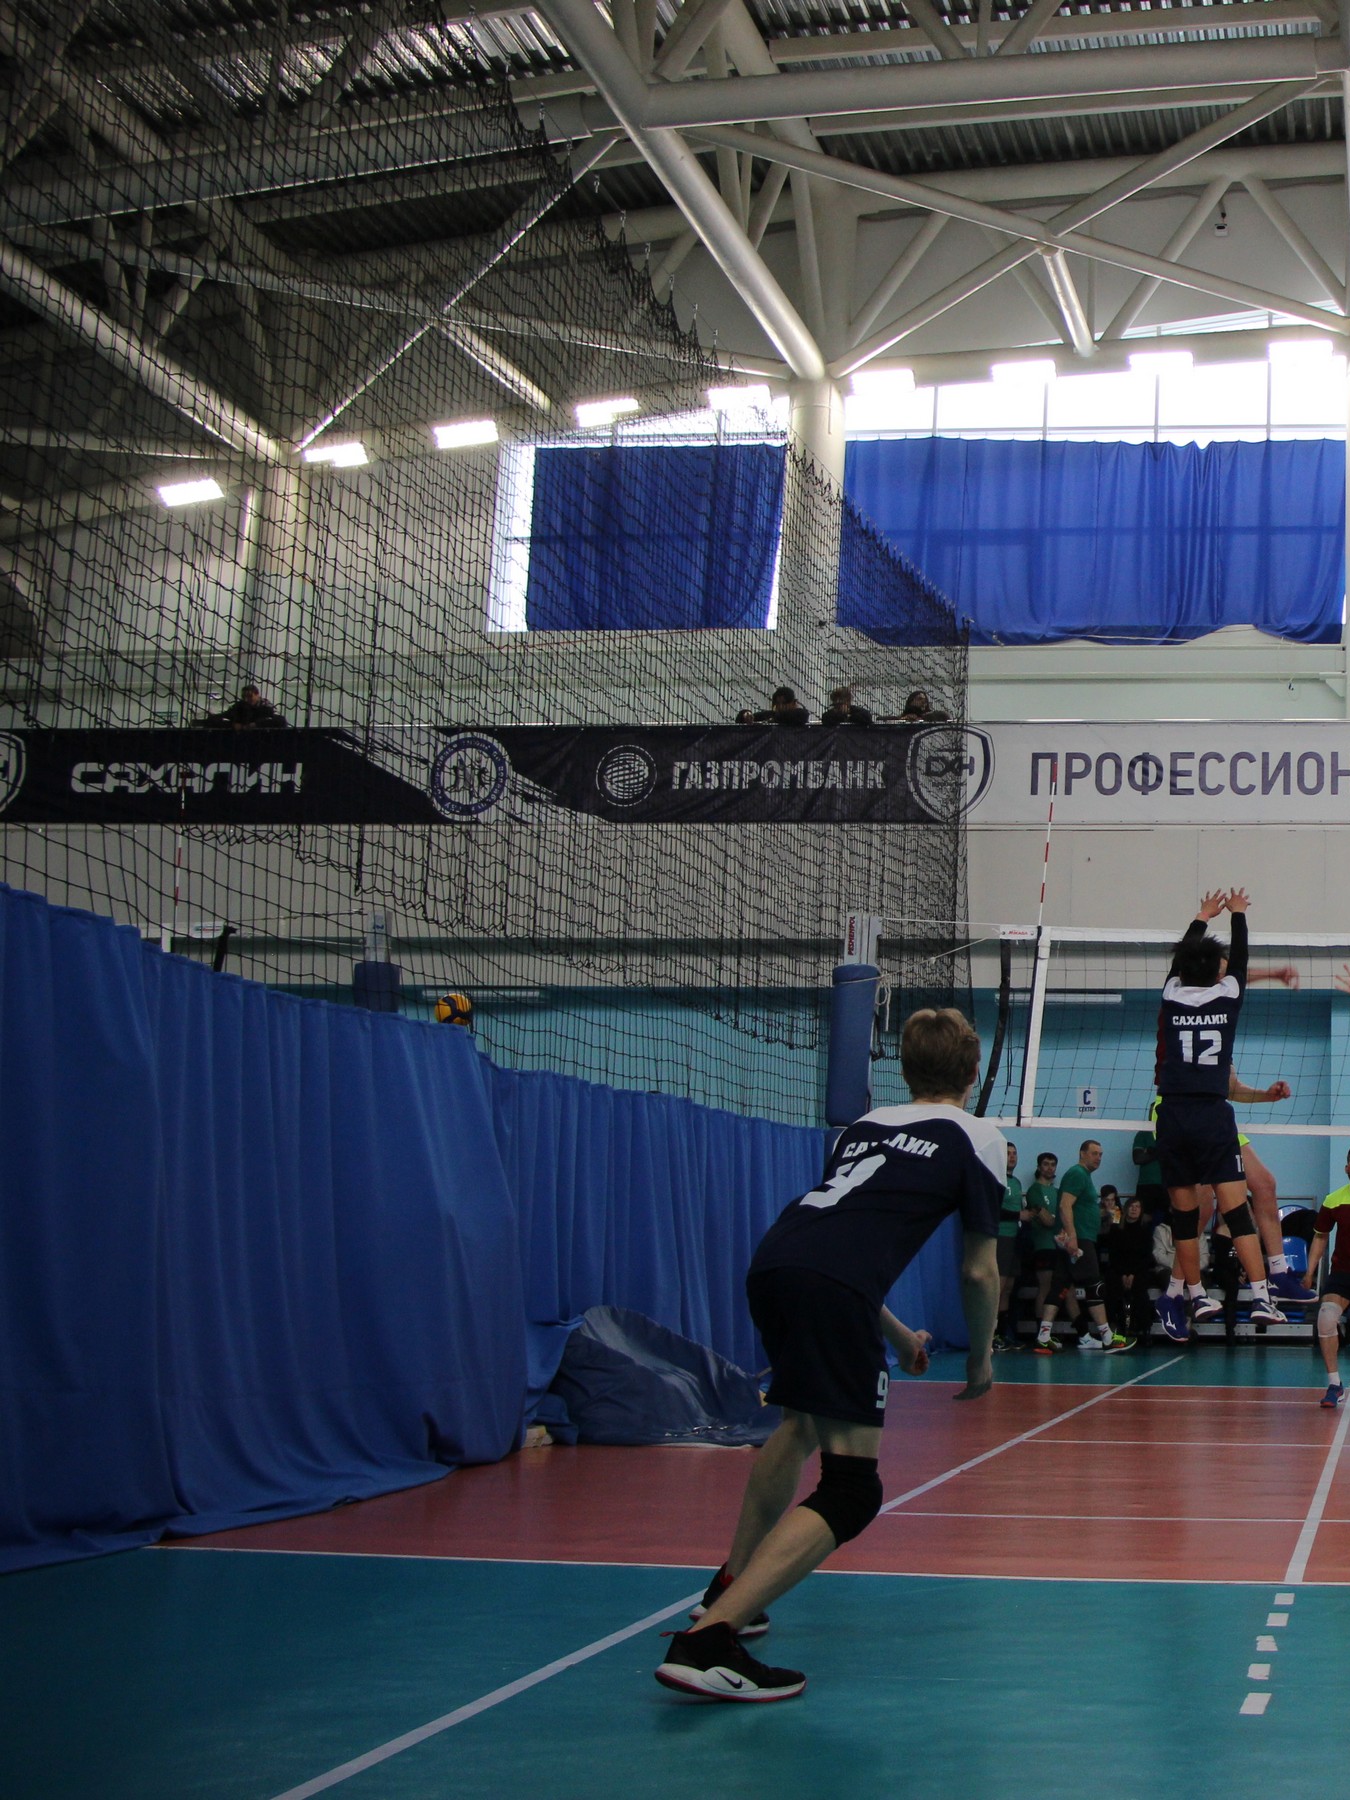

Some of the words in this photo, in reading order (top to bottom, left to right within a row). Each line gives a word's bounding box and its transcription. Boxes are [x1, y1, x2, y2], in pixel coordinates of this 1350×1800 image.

[71, 762, 303, 793] САХАЛИН
[672, 760, 887, 790] ГАЗПРОМБАНК
[1172, 1012, 1228, 1026] САХАЛИН
[1179, 1030, 1223, 1066] 12
[1083, 1089, 1092, 1106] C
[842, 1132, 939, 1158] САЛИН
[875, 1370, 889, 1409] 9
